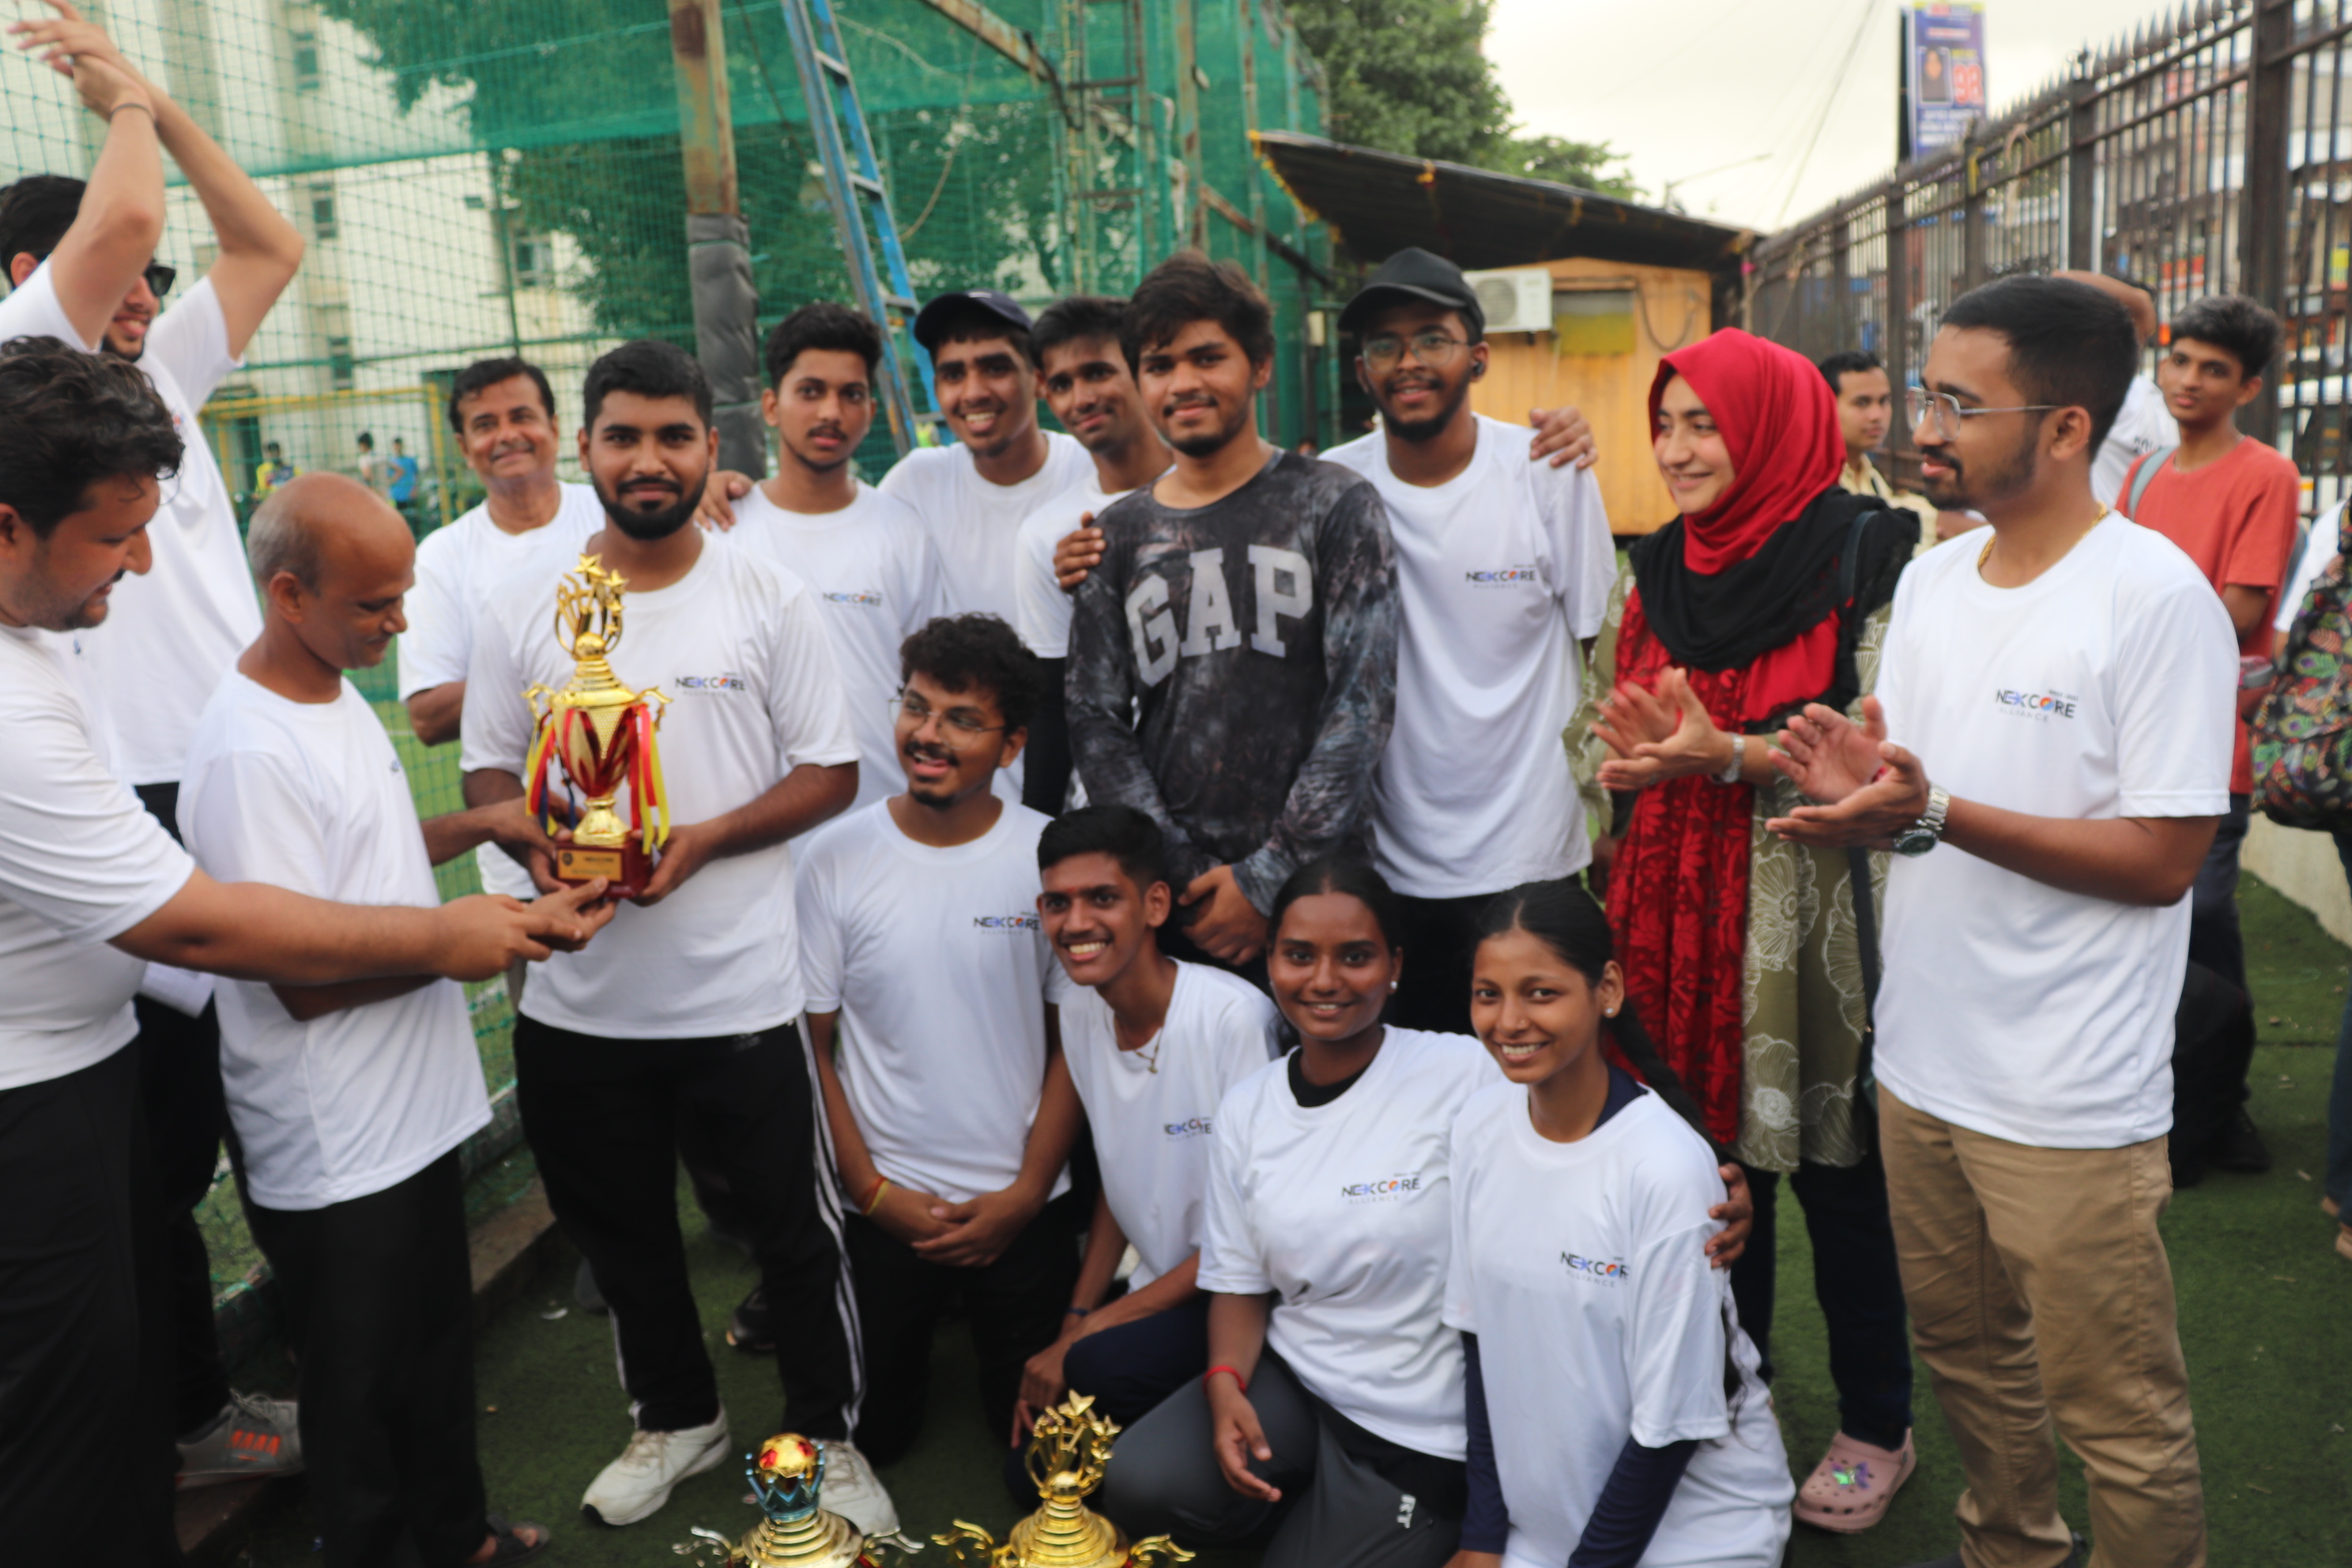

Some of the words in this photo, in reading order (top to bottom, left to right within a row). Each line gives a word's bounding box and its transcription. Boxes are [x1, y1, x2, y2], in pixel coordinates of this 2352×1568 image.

[1465, 570, 1536, 582] NEXCORE
[1125, 544, 1313, 688] GAP
[1996, 689, 2077, 718] NEXCORE
[1342, 1178, 1422, 1197] NEXCORE
